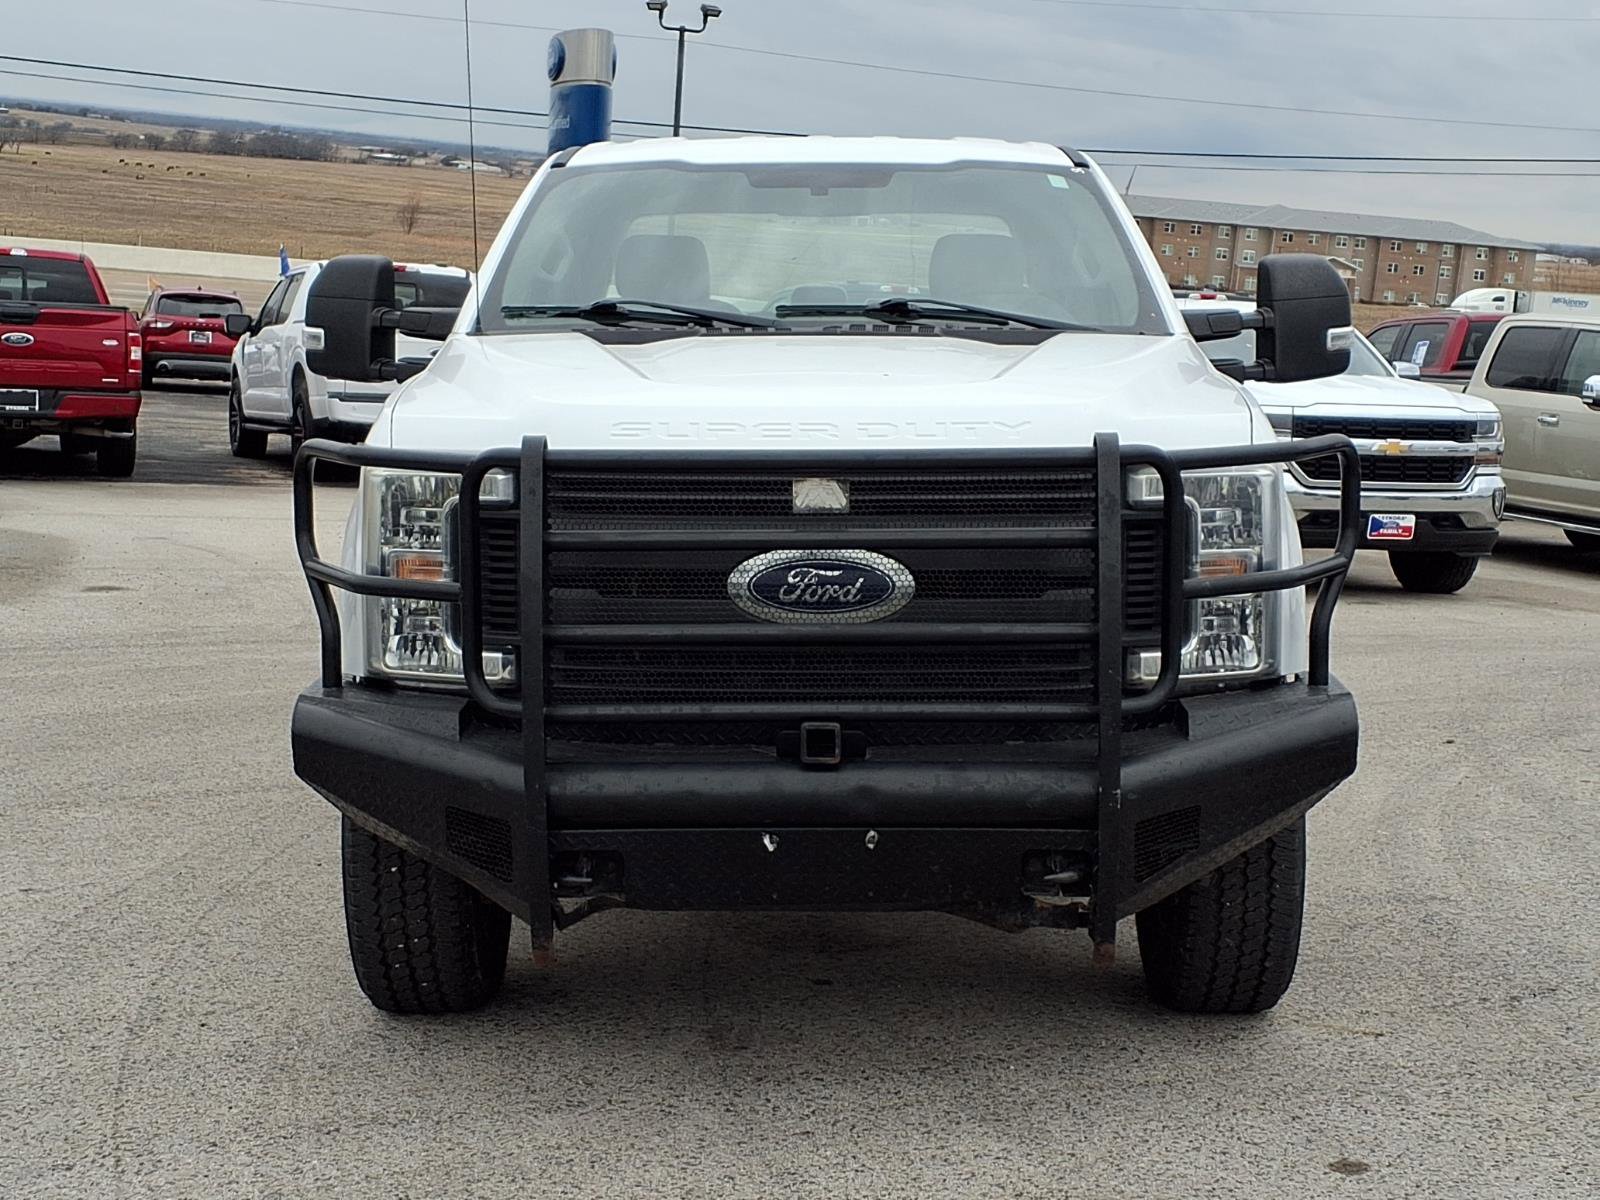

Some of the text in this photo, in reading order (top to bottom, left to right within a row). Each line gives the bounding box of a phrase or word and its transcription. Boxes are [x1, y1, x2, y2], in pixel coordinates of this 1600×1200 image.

[608, 420, 1032, 440] SUPER DUTY
[778, 567, 865, 602] Ford
